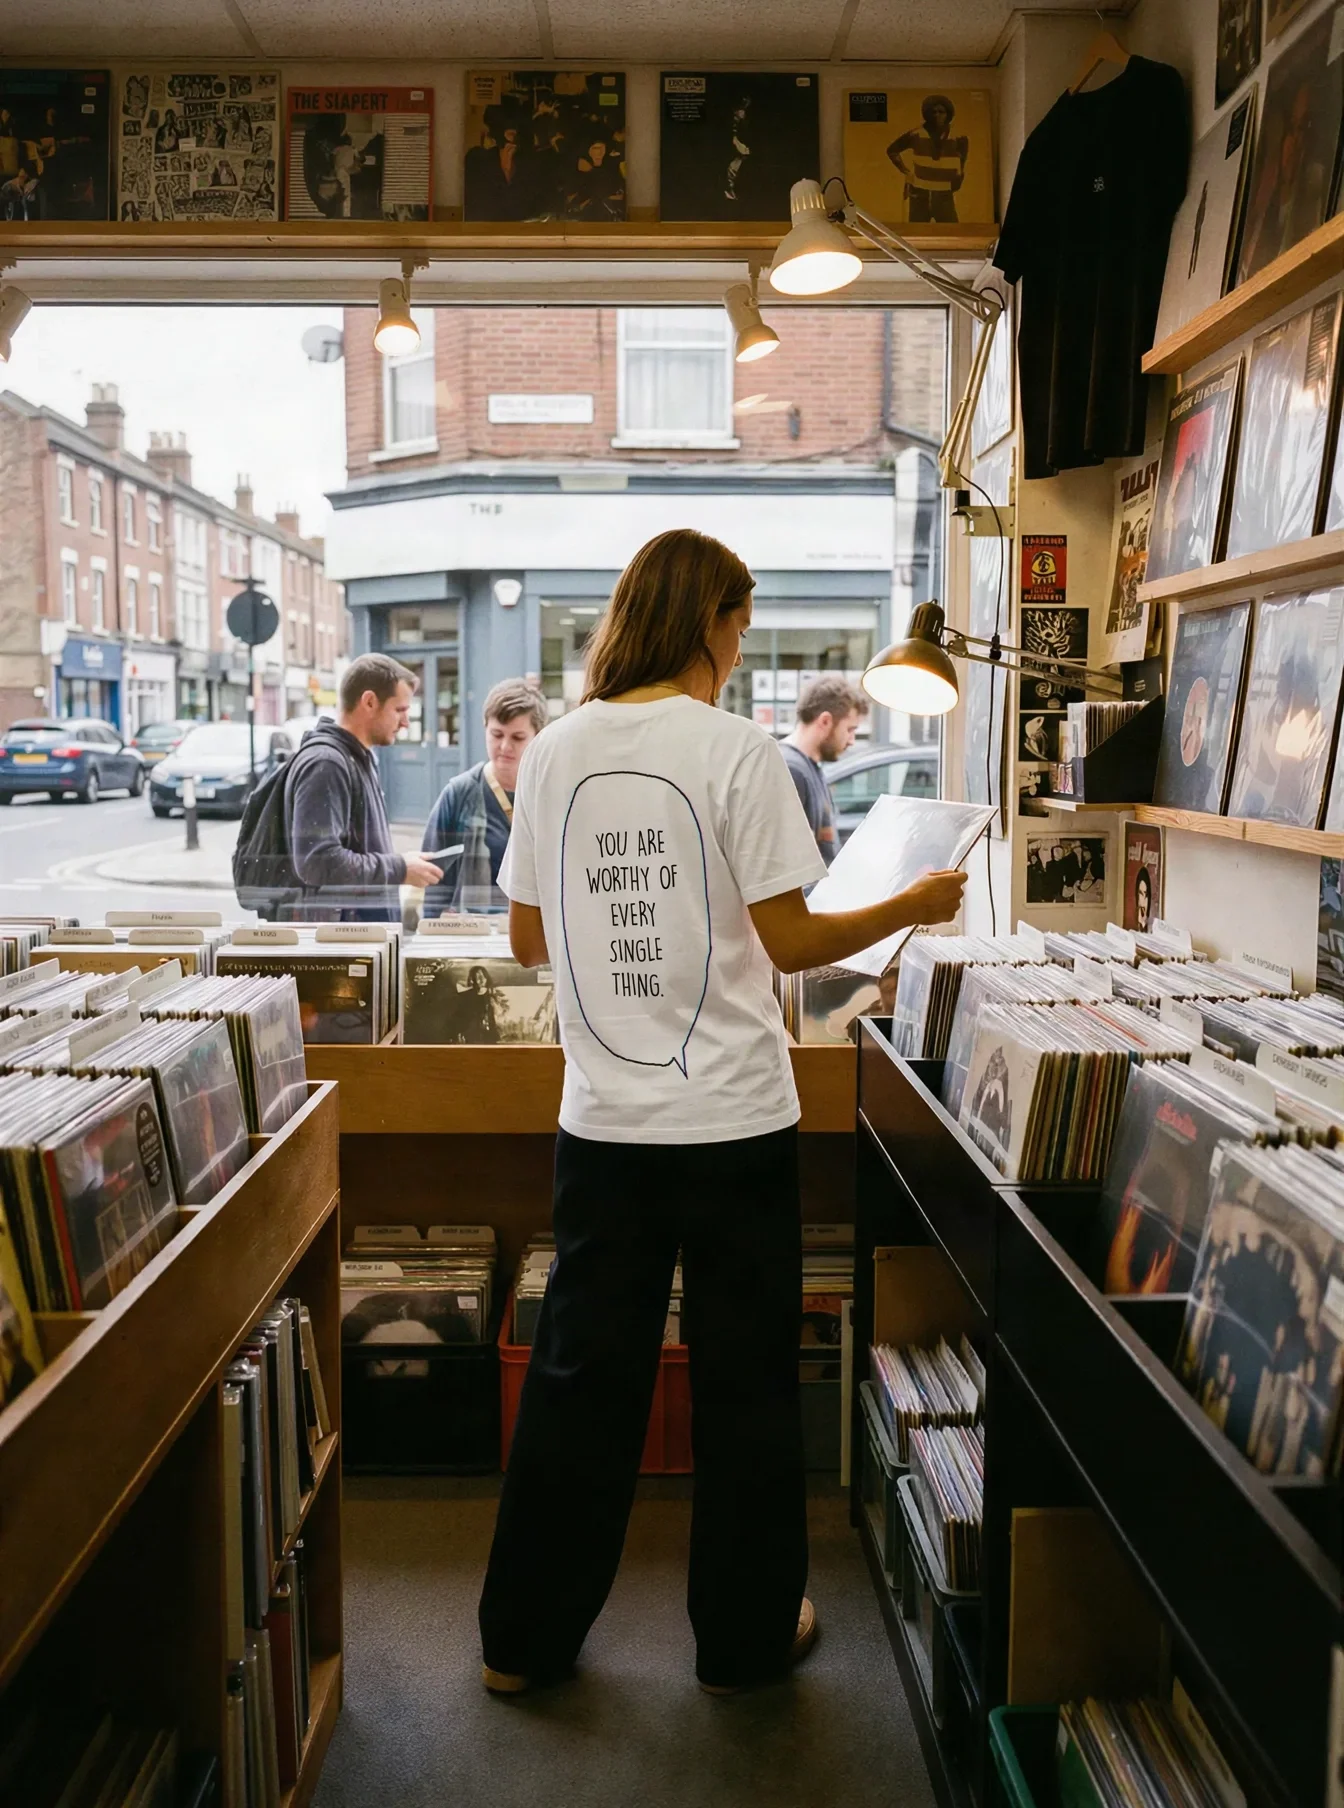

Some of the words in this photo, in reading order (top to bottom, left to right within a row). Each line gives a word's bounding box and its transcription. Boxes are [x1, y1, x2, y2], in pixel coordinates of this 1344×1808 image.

[292, 92, 320, 110] THE
[595, 831, 628, 858] YOU
[637, 828, 665, 857] ARE
[586, 865, 650, 894] WORTHY
[659, 864, 678, 890] OF
[610, 900, 656, 928] EVERY
[609, 936, 663, 963] SINGLE
[611, 972, 665, 998] THING.
